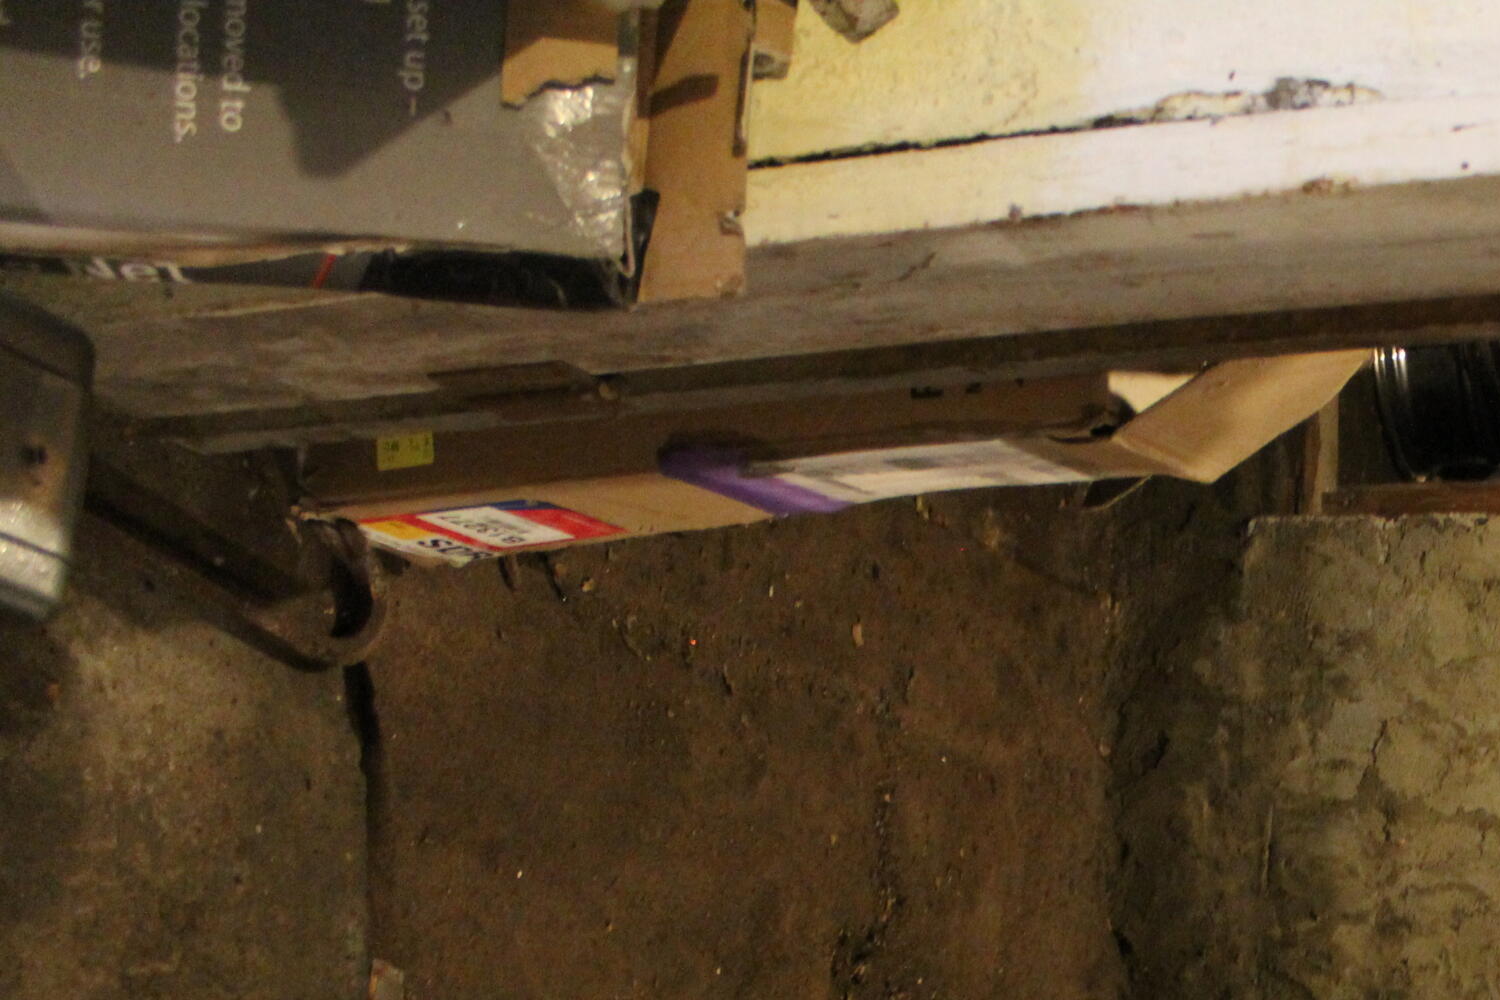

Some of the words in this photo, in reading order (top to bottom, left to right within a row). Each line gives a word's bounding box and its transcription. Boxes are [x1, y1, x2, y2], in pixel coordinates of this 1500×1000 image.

[78, 20, 101, 79] use.
[398, 52, 426, 91] up
[219, 99, 245, 133] to
